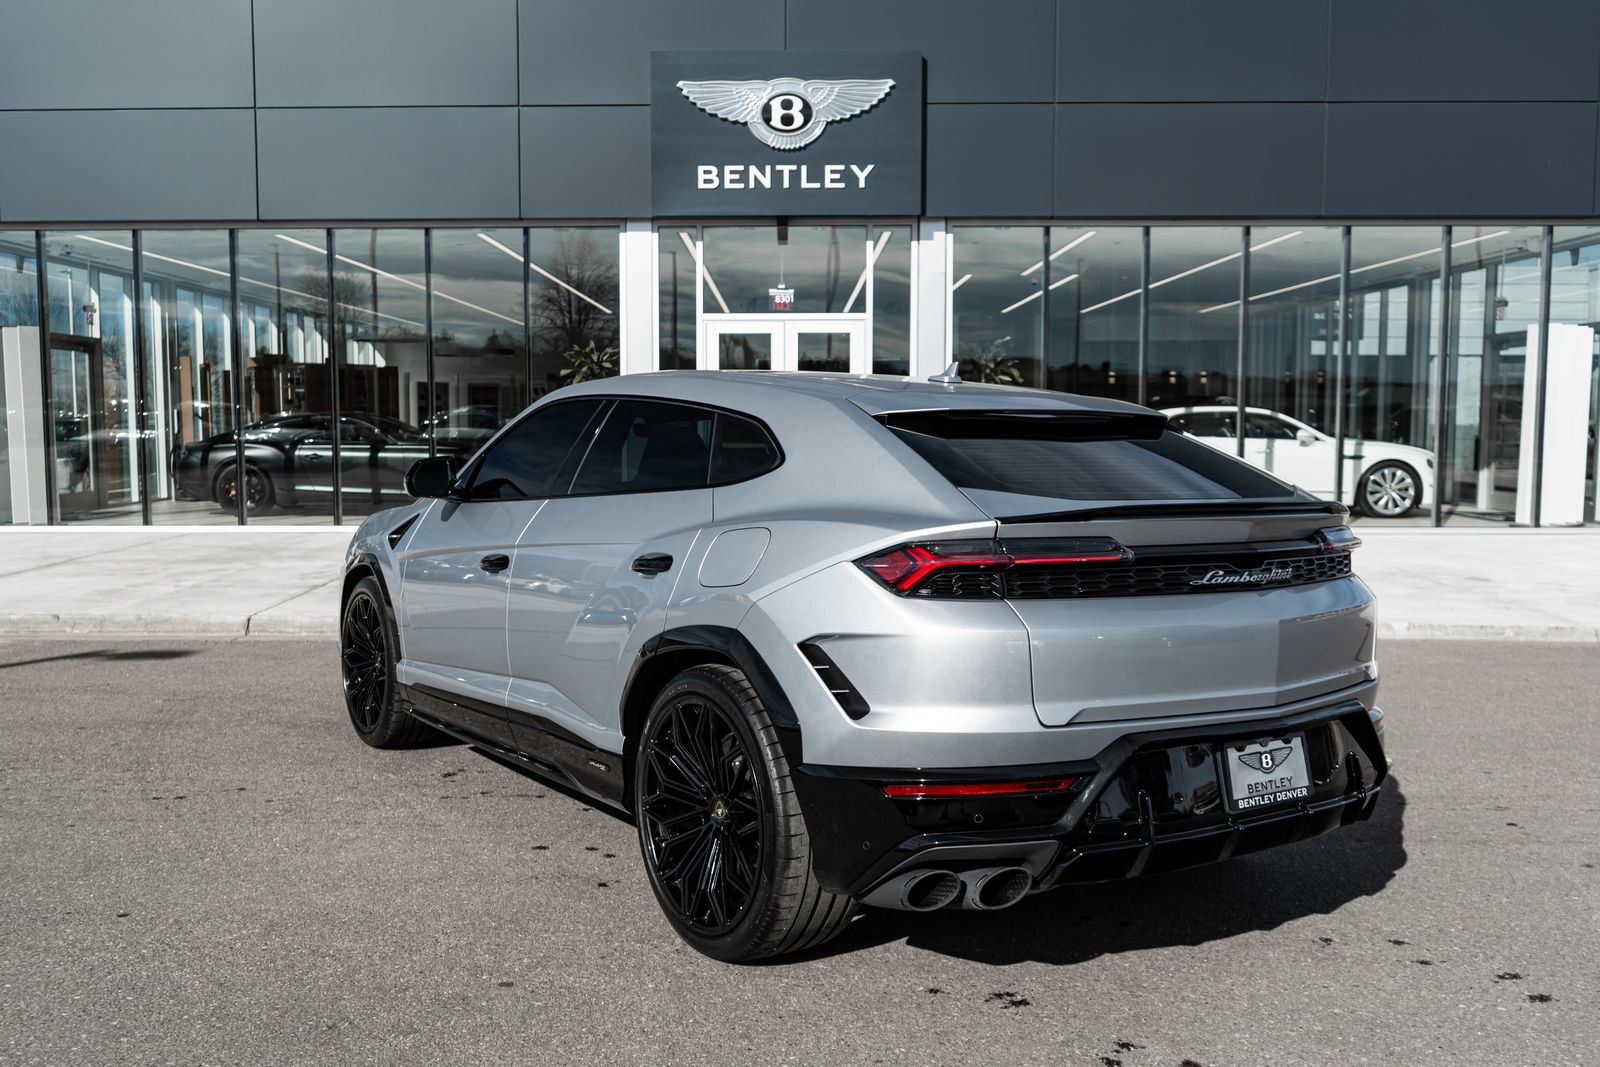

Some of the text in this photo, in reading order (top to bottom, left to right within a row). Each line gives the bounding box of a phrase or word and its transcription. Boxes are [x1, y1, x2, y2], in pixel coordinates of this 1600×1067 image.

[769, 98, 804, 130] B
[697, 165, 875, 189] BENTLEY
[775, 295, 794, 303] 8301
[1189, 567, 1293, 585] Lamborghini
[1247, 776, 1293, 794] BENTLEY
[1238, 787, 1308, 809] BENTLEY DENVER
